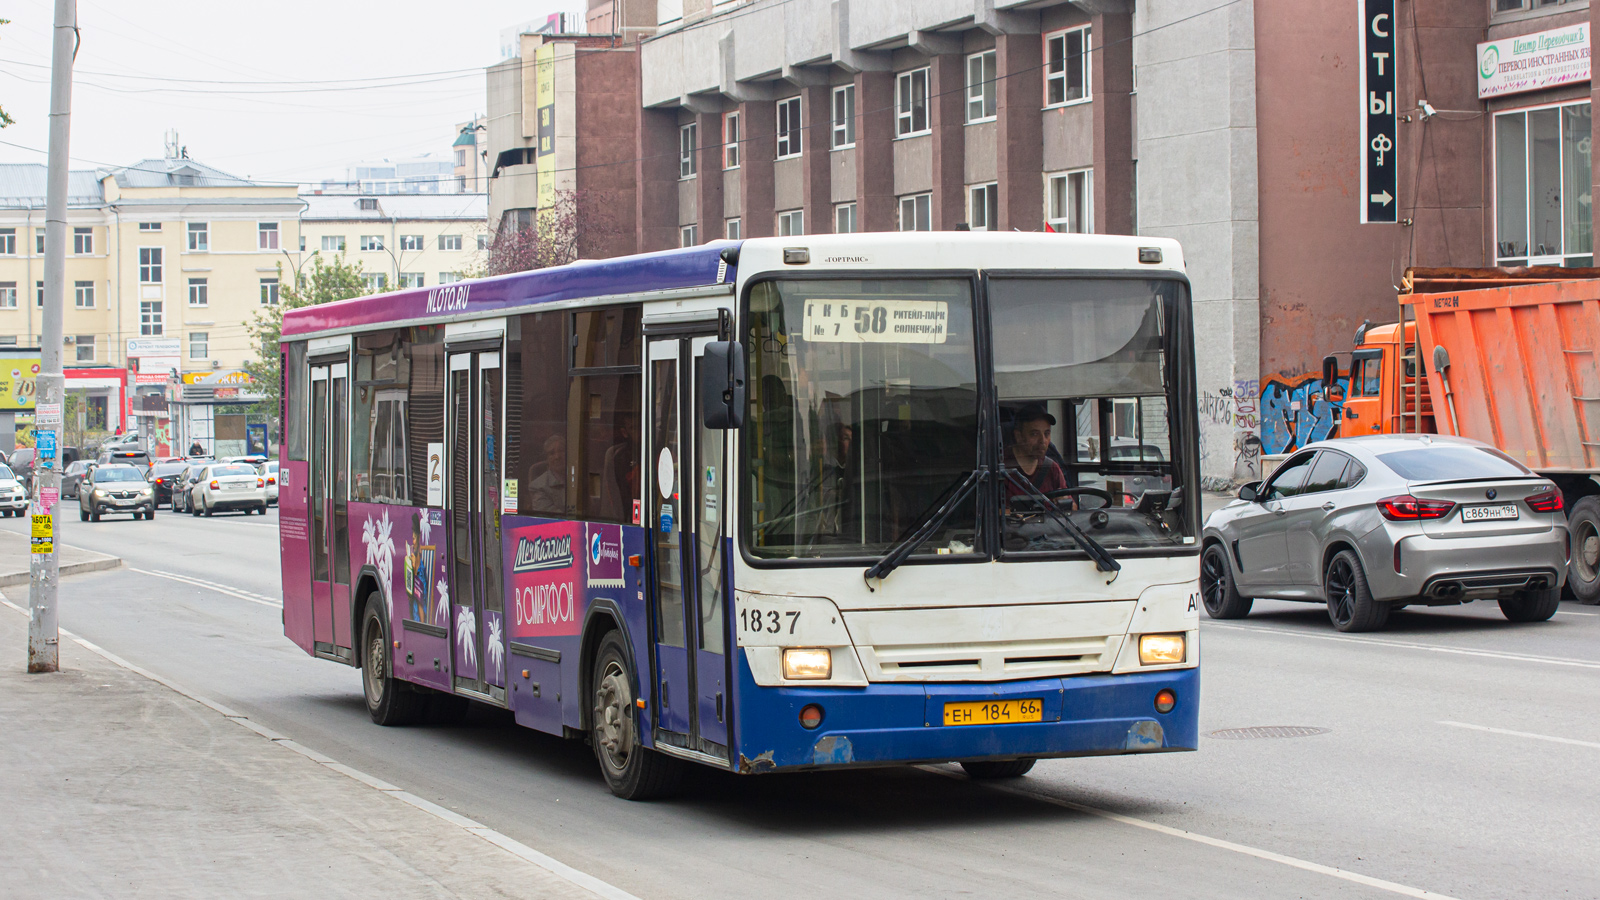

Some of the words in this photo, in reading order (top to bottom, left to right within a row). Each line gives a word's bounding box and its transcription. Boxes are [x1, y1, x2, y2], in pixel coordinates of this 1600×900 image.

[1513, 40, 1537, 54] Центр
[1538, 28, 1584, 50] ПереводчикЪ
[1498, 60, 1527, 73] ПЕРЕВОД
[1527, 49, 1579, 68] ИНОСТРАННЫХ
[1504, 71, 1537, 82] TRANSLATION
[1542, 64, 1580, 75] INTERPRETING
[426, 285, 470, 313] NLOTO.RU
[854, 306, 887, 334] 58
[893, 309, 945, 320] РИТЕЙЛ-ПАРК
[814, 325, 825, 335] №
[834, 323, 841, 336] 7
[894, 324, 943, 334] СОЛНЕЧНЫЙ
[1502, 505, 1516, 514] 196
[515, 588, 523, 625] В
[523, 582, 574, 624] СМАРТФОН
[740, 608, 801, 634] 1837
[952, 709, 972, 722] ЕН
[981, 703, 1010, 720] 184
[1020, 701, 1036, 714] 66
